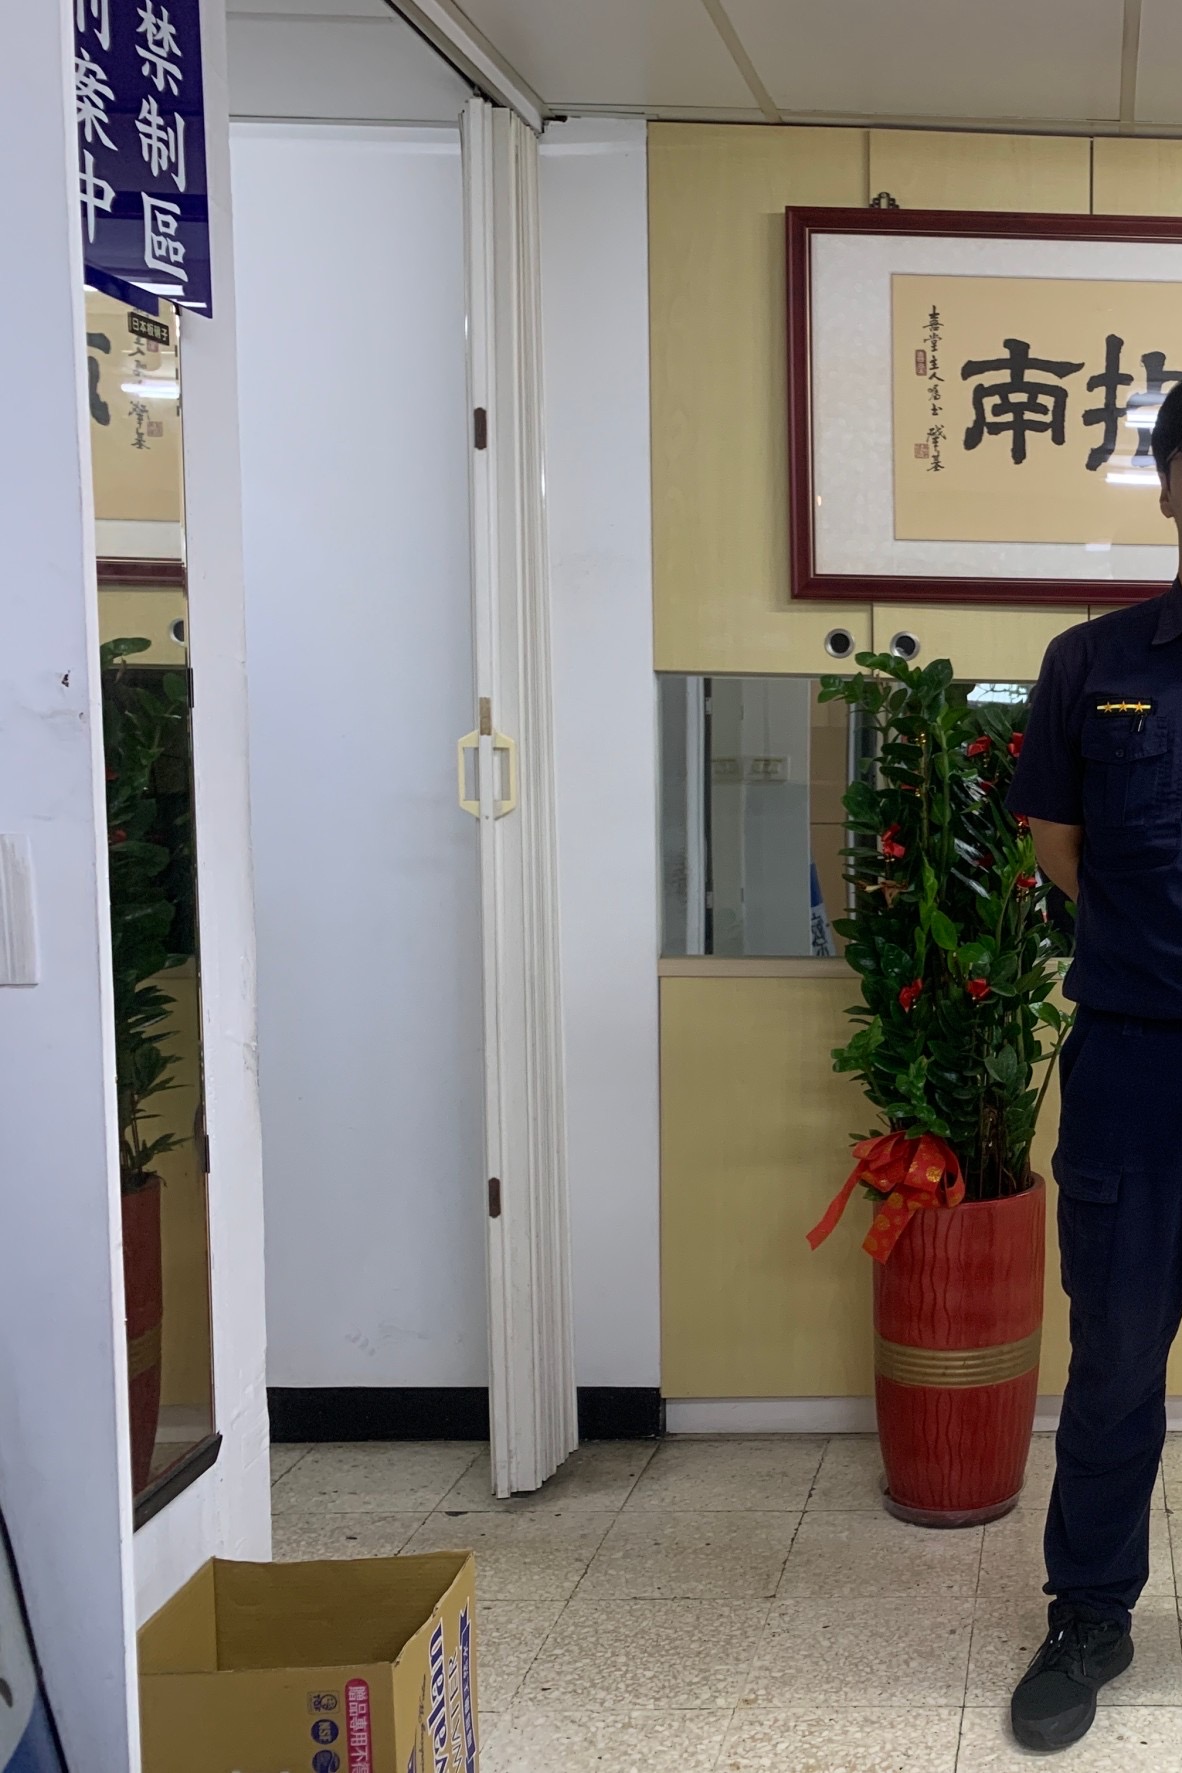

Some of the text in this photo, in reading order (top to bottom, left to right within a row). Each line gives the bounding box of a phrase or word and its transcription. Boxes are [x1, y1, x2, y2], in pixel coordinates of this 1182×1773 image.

[134, 0, 189, 282] 禁制區
[132, 319, 169, 341] 日本板硝子
[317, 1721, 331, 1742] NSF
